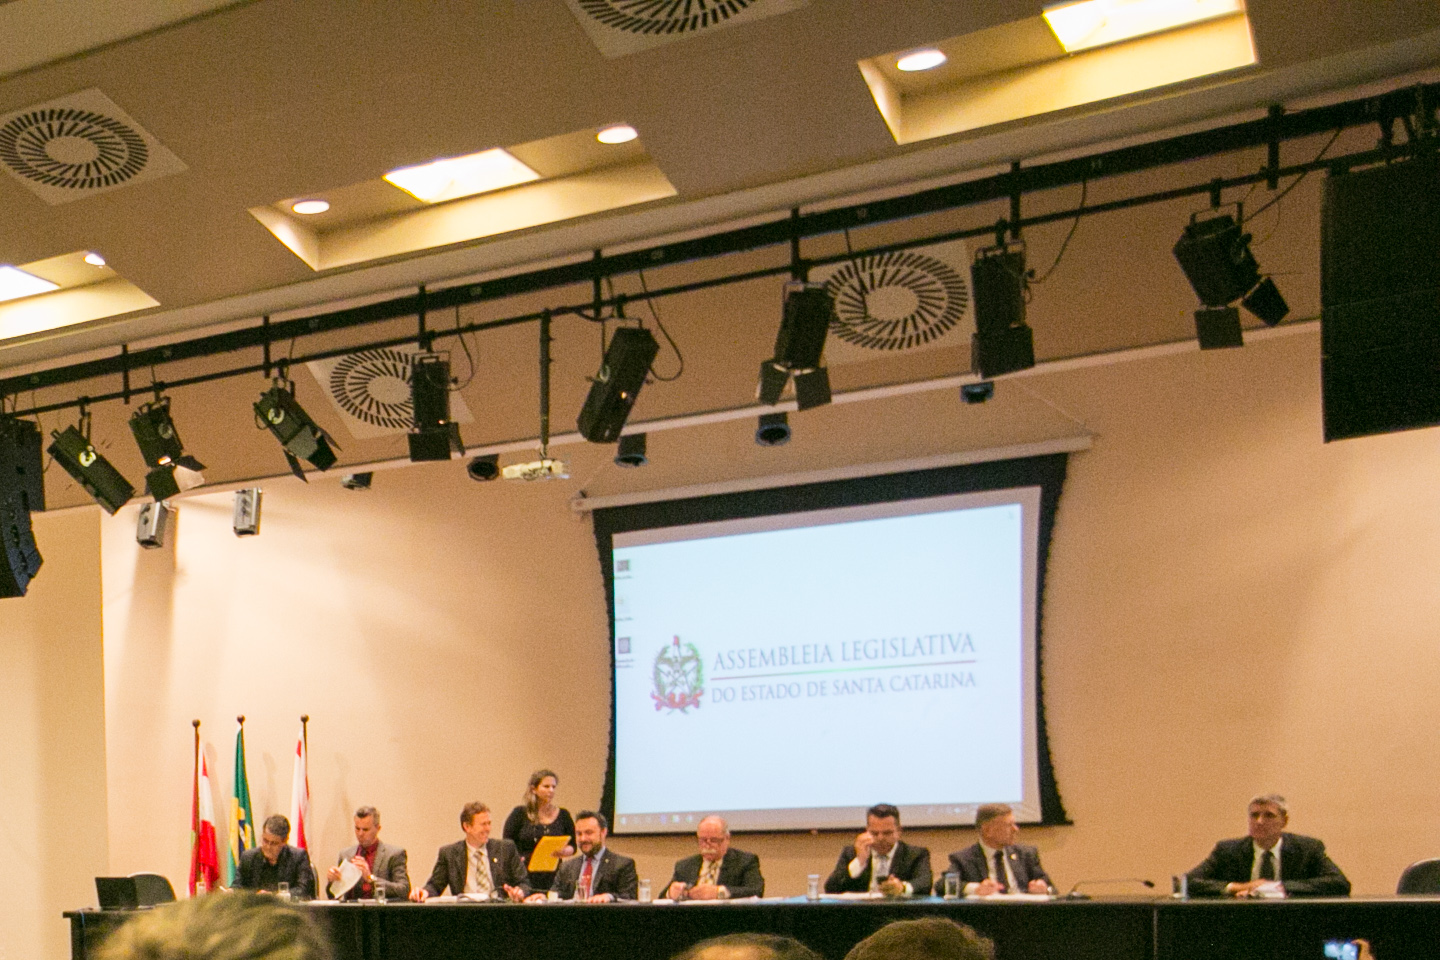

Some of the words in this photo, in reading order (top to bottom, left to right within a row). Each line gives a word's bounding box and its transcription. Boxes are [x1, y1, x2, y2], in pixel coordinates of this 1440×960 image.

[713, 643, 834, 671] ASSEMBLEIA
[841, 632, 976, 662] LEGISLATIVA
[711, 686, 736, 703] DO
[741, 682, 801, 702] ESTADO
[807, 680, 827, 697] DE
[832, 677, 885, 696] SANTA
[890, 672, 976, 692] CATARINA
